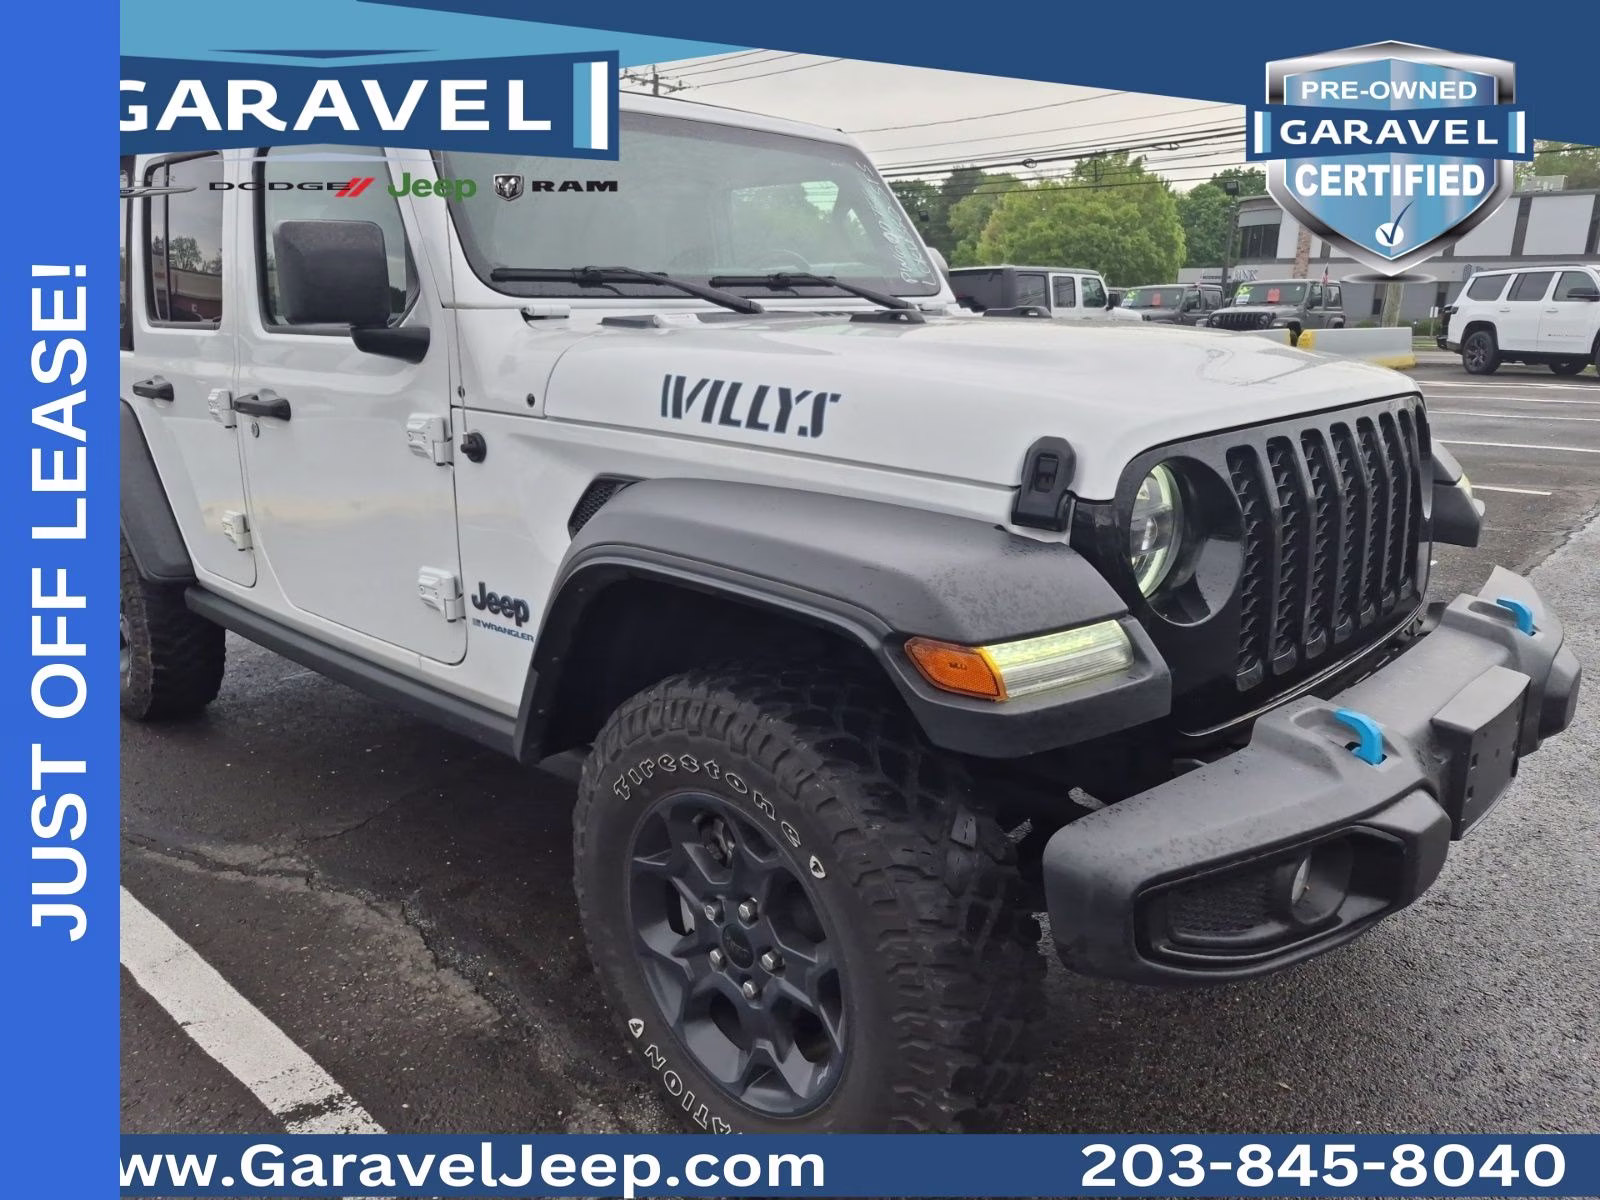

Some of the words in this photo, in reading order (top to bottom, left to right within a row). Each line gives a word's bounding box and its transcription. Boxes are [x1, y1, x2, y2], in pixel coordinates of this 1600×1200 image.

[660, 373, 842, 438] WILLYS
[471, 581, 530, 628] Jeep
[481, 620, 534, 643] WRANGLER
[613, 754, 802, 848] Firestone
